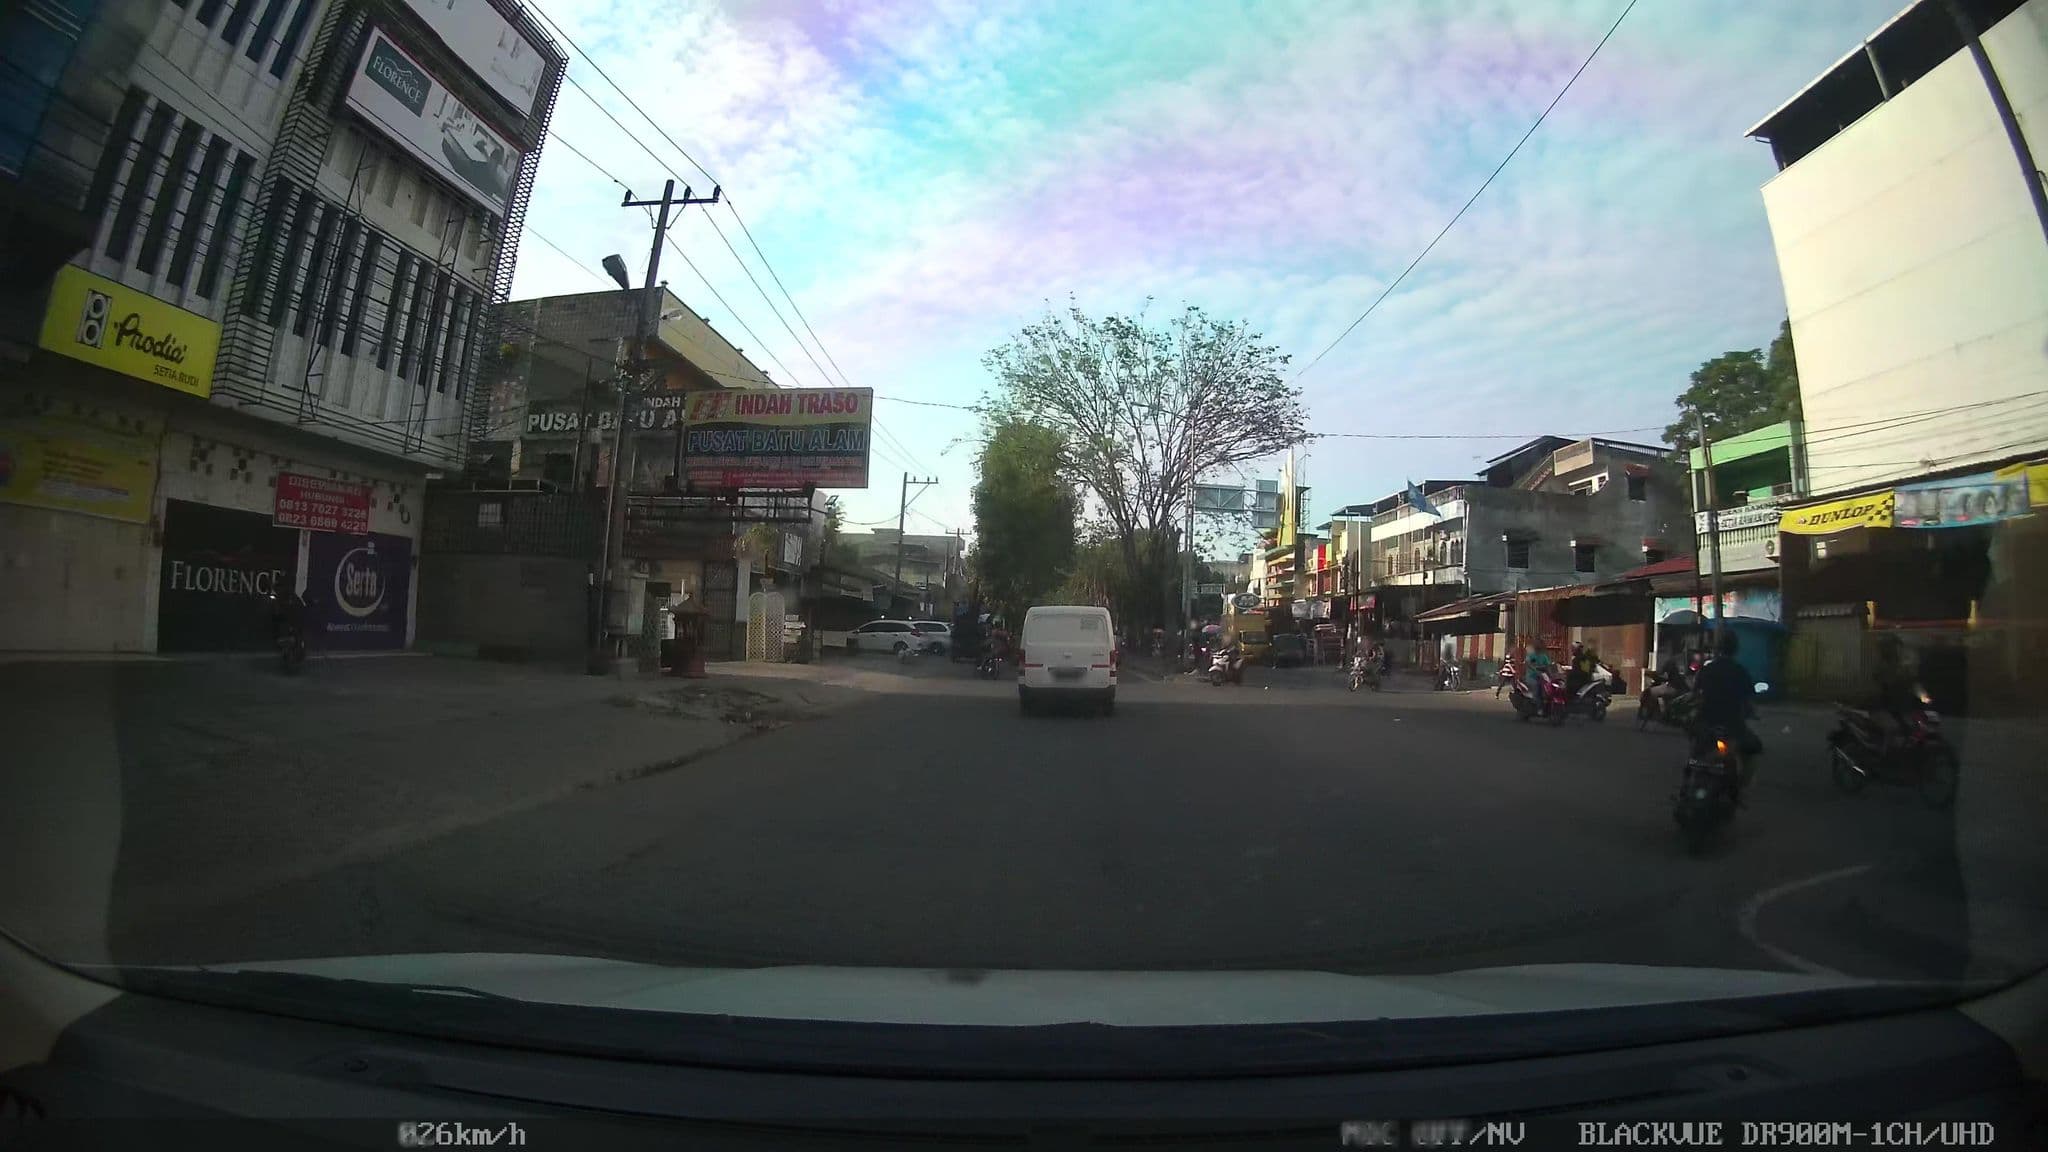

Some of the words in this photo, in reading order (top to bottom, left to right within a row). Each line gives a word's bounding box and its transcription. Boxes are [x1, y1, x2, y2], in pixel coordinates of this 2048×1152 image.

[373, 55, 424, 104] FLORENCE
[735, 394, 793, 416] INDAH
[797, 391, 859, 414] TRASO
[688, 430, 748, 452] PUSAT
[752, 429, 806, 451] BATU
[808, 428, 865, 451] ALAM
[1808, 503, 1875, 526] DUNLOP
[170, 560, 281, 596] FLORENCE
[345, 562, 378, 599] Serta
